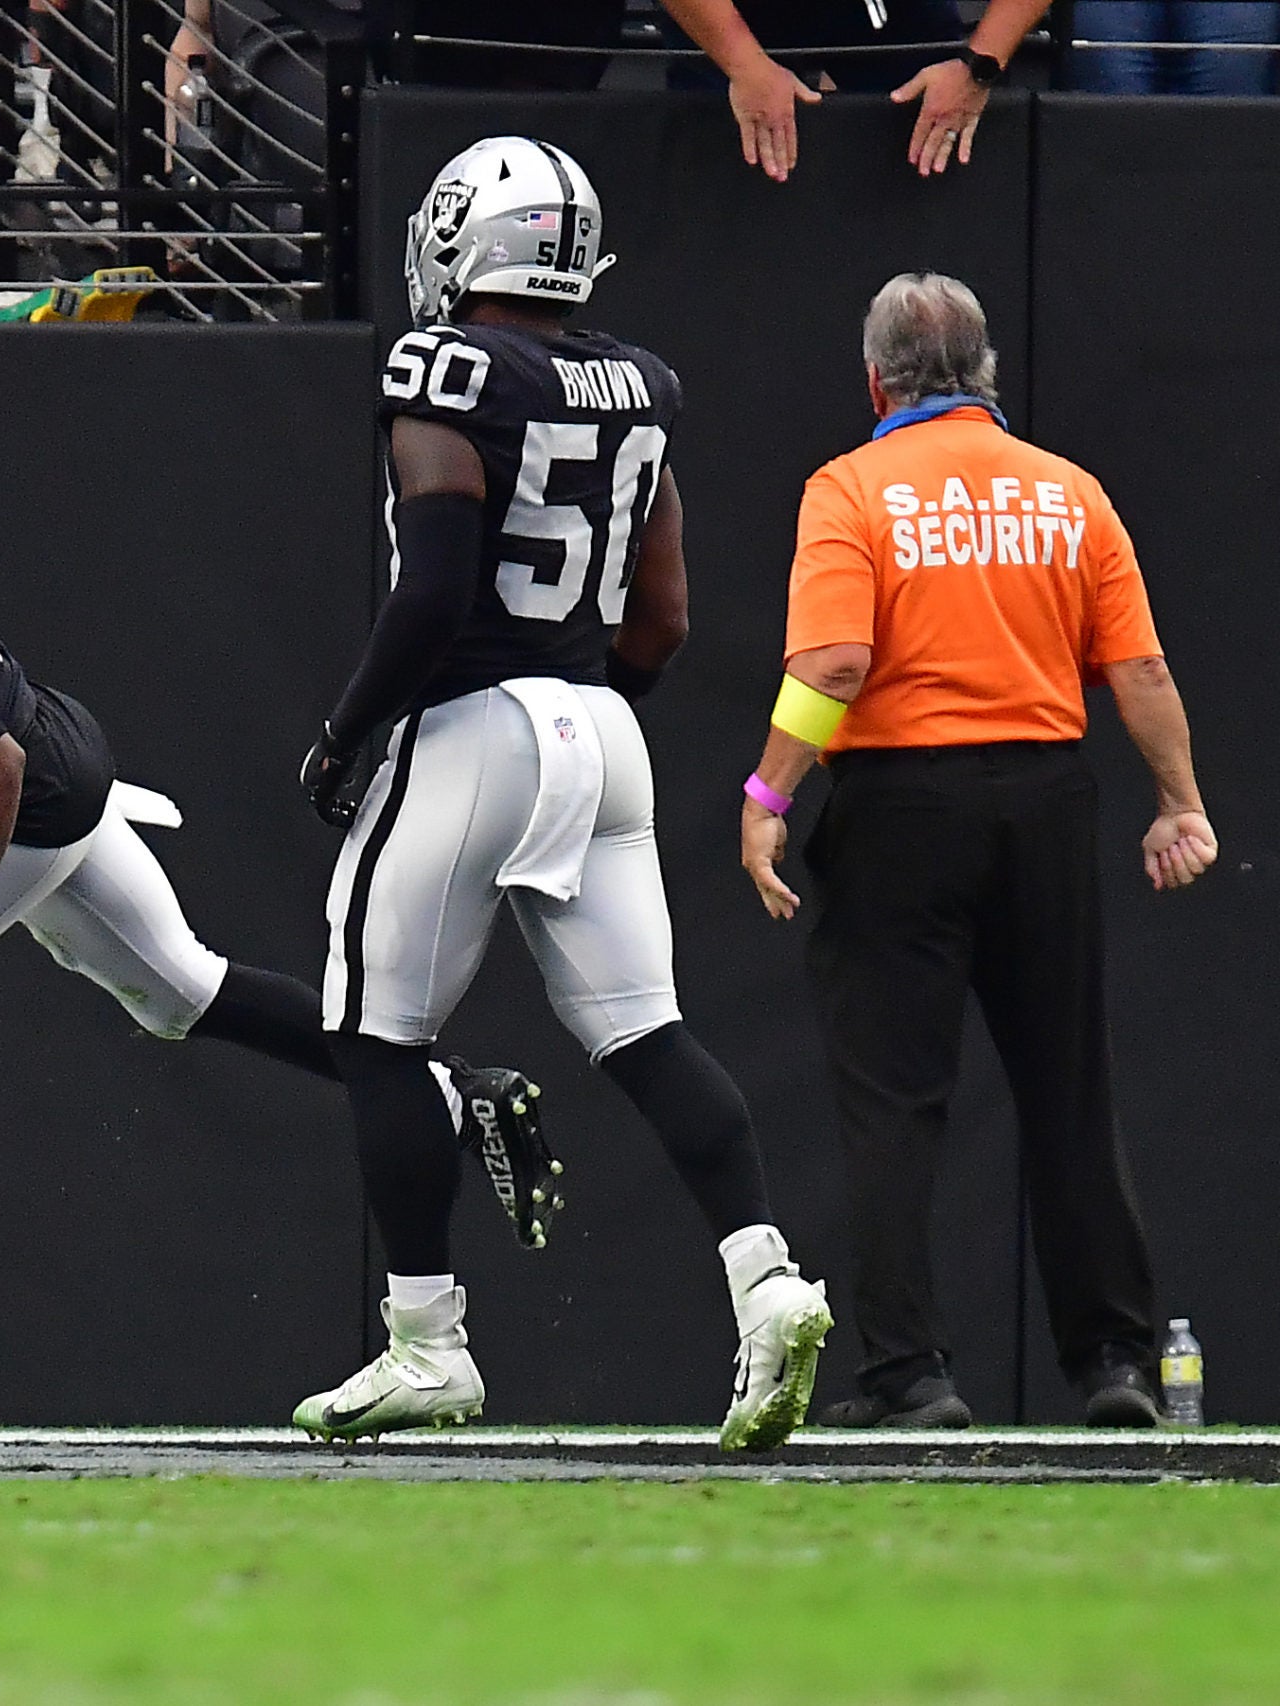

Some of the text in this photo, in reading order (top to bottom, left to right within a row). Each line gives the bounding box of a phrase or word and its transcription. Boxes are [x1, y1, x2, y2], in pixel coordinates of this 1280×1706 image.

[382, 331, 492, 412] 50
[551, 356, 652, 411] BROWN
[882, 477, 1085, 518] S.A.F.E.
[892, 513, 1086, 570] SECURITY
